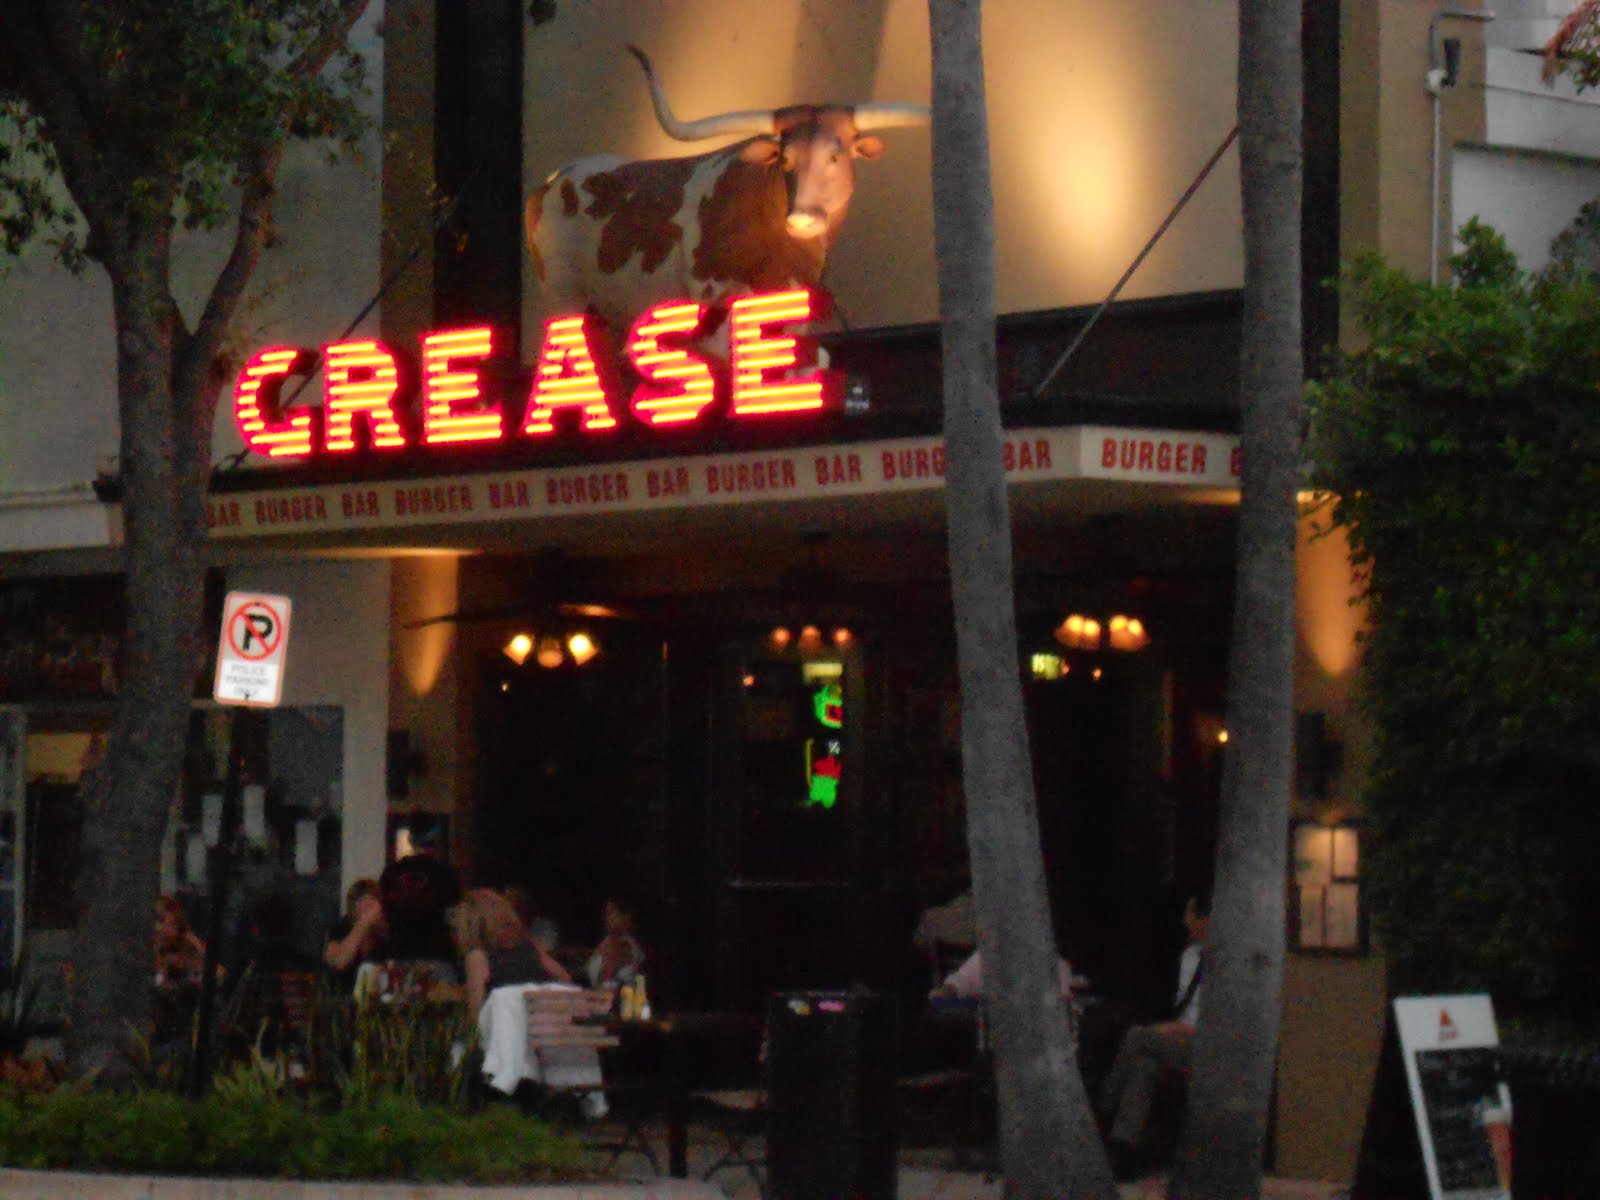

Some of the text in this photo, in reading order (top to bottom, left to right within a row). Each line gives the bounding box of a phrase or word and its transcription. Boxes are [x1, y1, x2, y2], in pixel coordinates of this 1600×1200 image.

[234, 287, 825, 460] GREASE
[255, 495, 327, 525] BURGER
[341, 490, 380, 519] BAR
[395, 484, 473, 516] BURGER
[488, 480, 530, 509] BAR
[545, 472, 629, 504] BURGER
[646, 465, 691, 498] BAR
[706, 459, 796, 494] BURGER
[815, 453, 862, 486] BAR
[881, 446, 945, 481] BURG
[1003, 440, 1052, 471] BAR
[1102, 437, 1208, 474] BURGER
